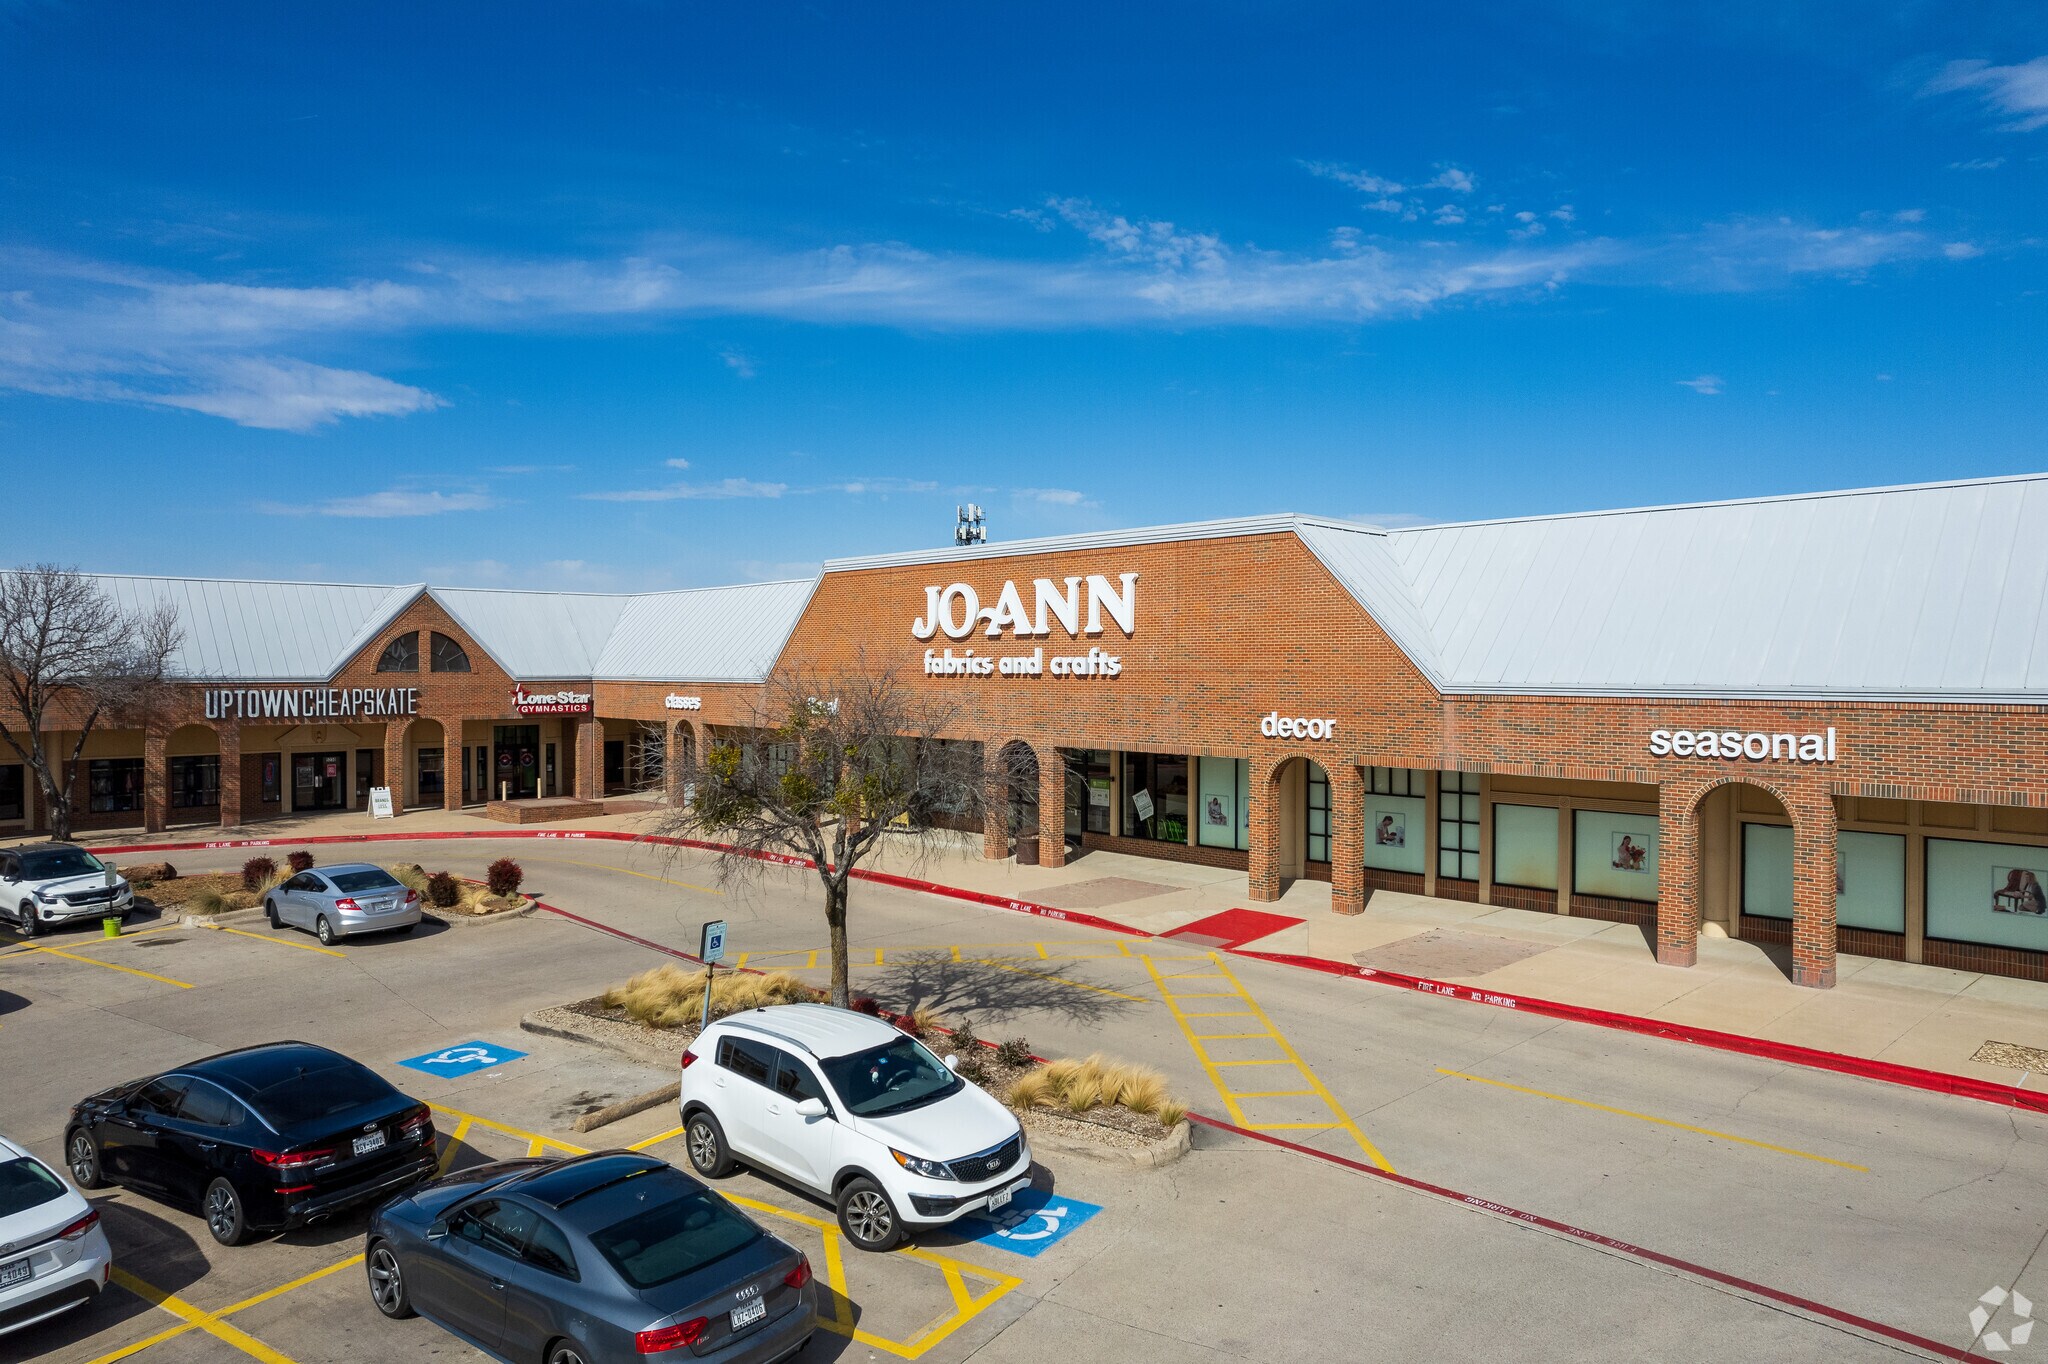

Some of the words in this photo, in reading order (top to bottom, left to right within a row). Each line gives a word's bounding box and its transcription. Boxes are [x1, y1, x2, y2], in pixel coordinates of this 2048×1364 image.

[924, 648, 995, 675] fabrics
[998, 647, 1043, 674] and
[1050, 647, 1122, 675] crafts
[517, 691, 557, 705] Lone
[557, 691, 591, 704] Star
[665, 693, 701, 710] classes
[521, 705, 587, 713] GYMNASTICS
[1261, 711, 1336, 739] decor
[1650, 727, 1836, 761] seasonal
[1047, 909, 1067, 920] PARKING
[1418, 981, 1434, 993] FIRE
[1436, 985, 1455, 996] LANE
[1471, 991, 1481, 1001] NO
[1484, 994, 1516, 1008] PARKING
[1464, 1196, 1515, 1216] PARKING
[1519, 1212, 1537, 1223] NO
[1567, 1226, 1600, 1242] LANE
[1609, 1239, 1637, 1253] FIRE
[0, 1266, 28, 1283] -4049
